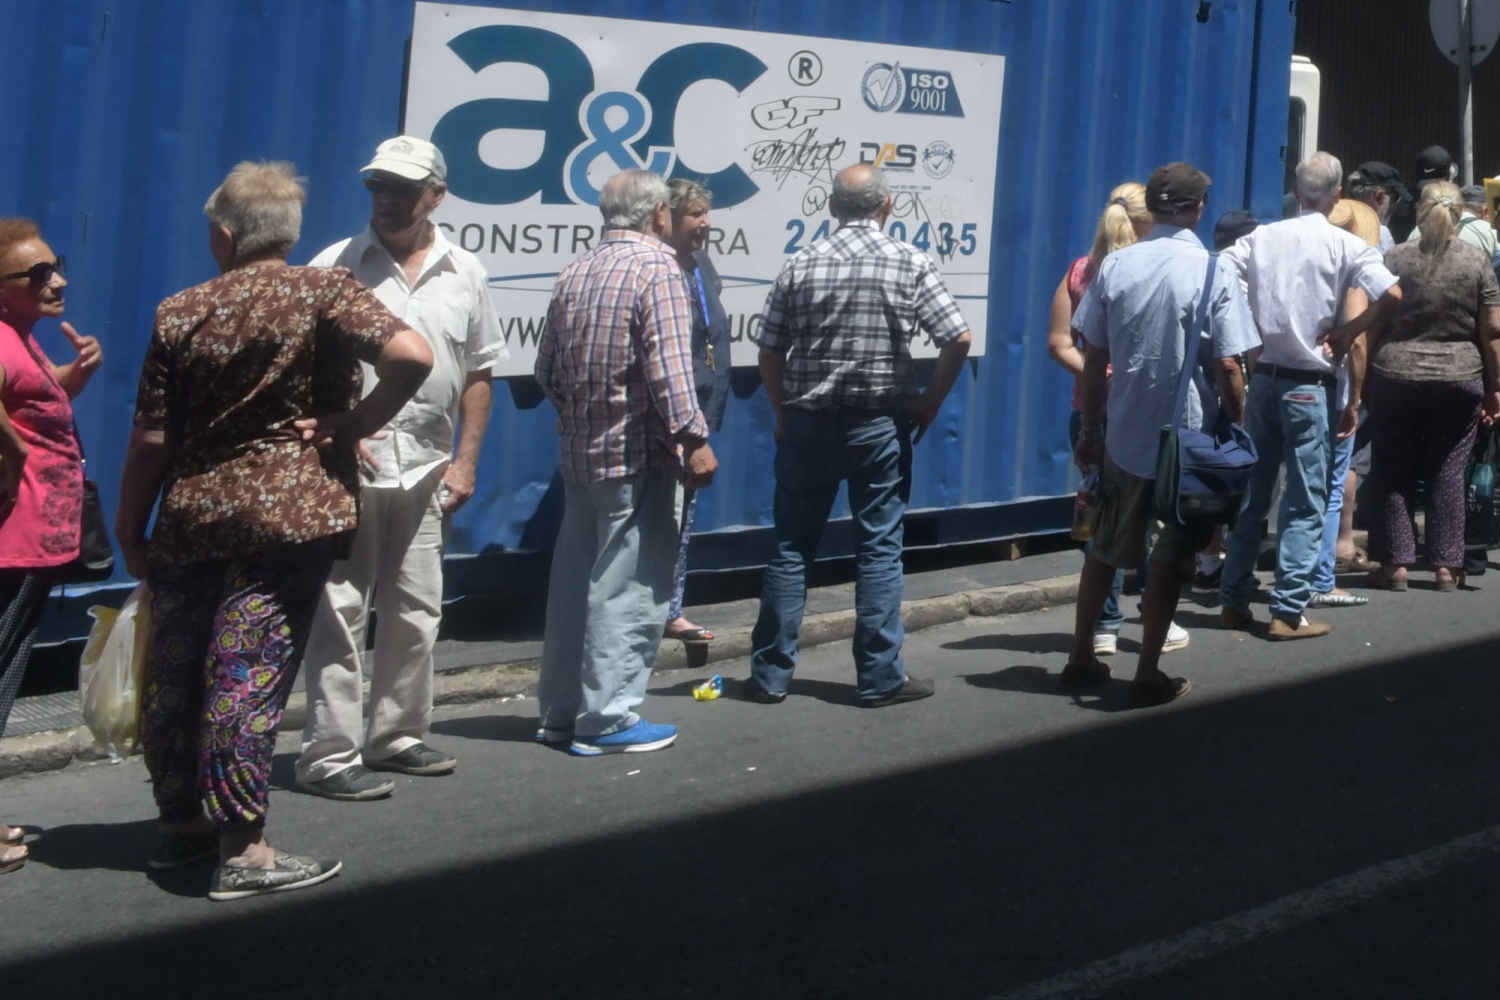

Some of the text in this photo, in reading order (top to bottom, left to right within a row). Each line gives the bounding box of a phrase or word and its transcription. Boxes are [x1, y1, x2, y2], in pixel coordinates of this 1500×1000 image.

[910, 73, 949, 88] ISO
[909, 88, 947, 112] 9001
[860, 141, 917, 168] DAS
